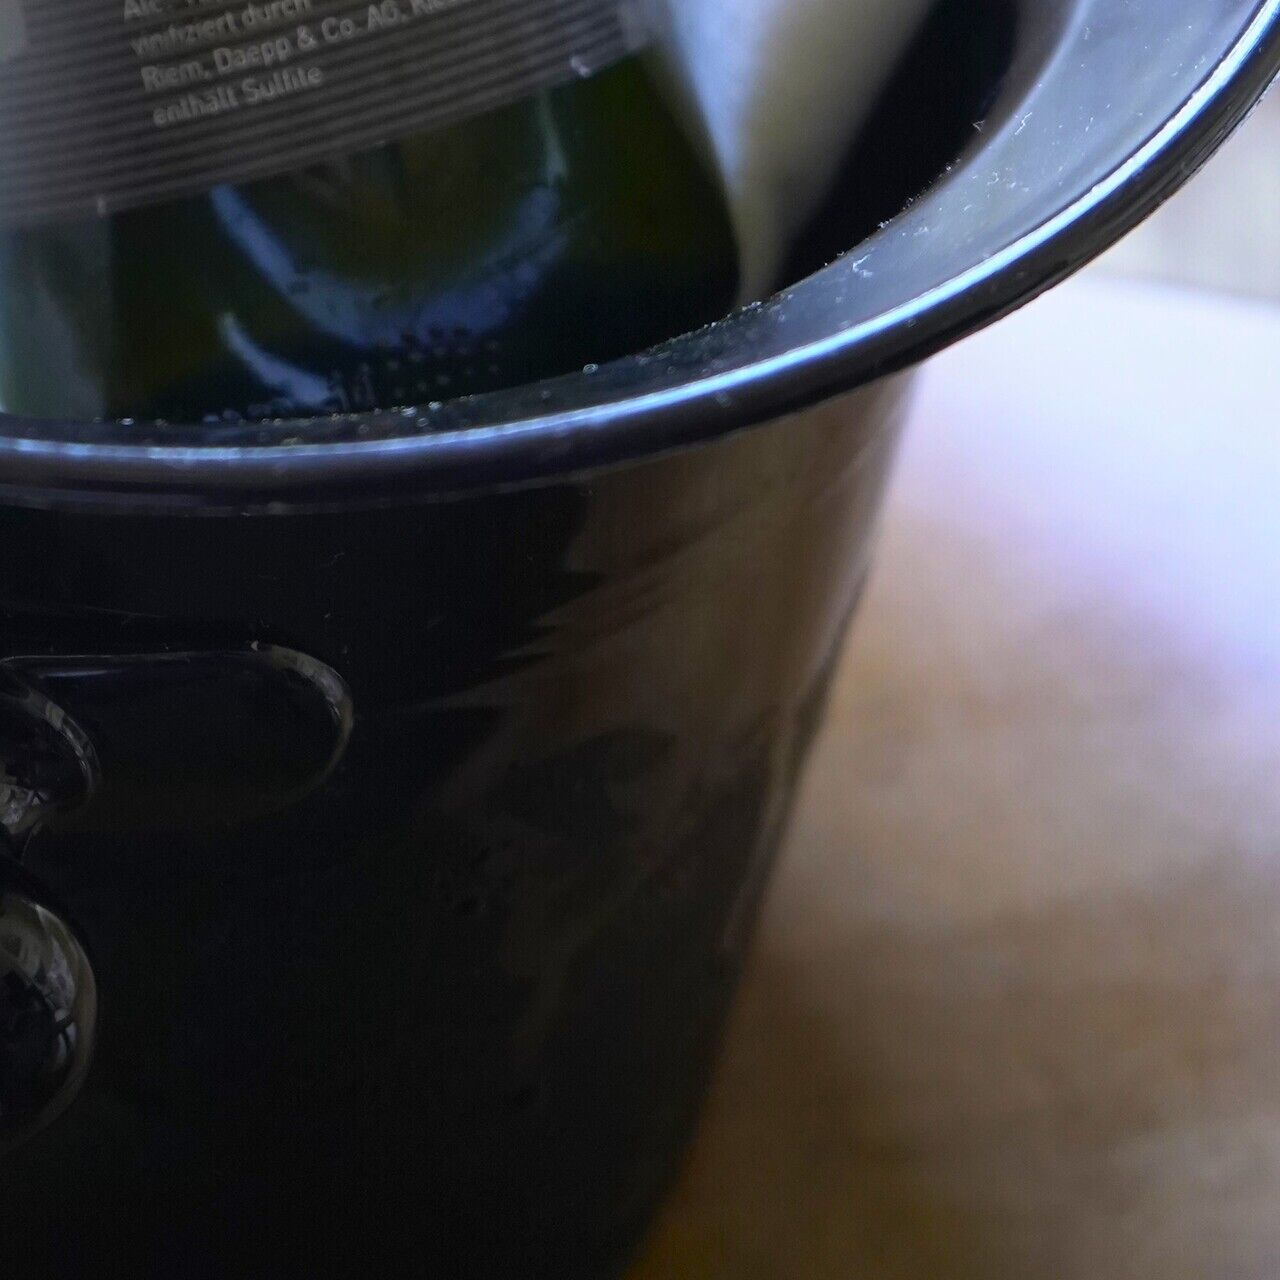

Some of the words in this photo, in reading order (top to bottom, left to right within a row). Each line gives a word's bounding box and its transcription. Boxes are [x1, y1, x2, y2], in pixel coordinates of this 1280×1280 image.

[214, 37, 294, 75] Daepp
[296, 24, 319, 52] &
[241, 66, 323, 105] Sulfite
